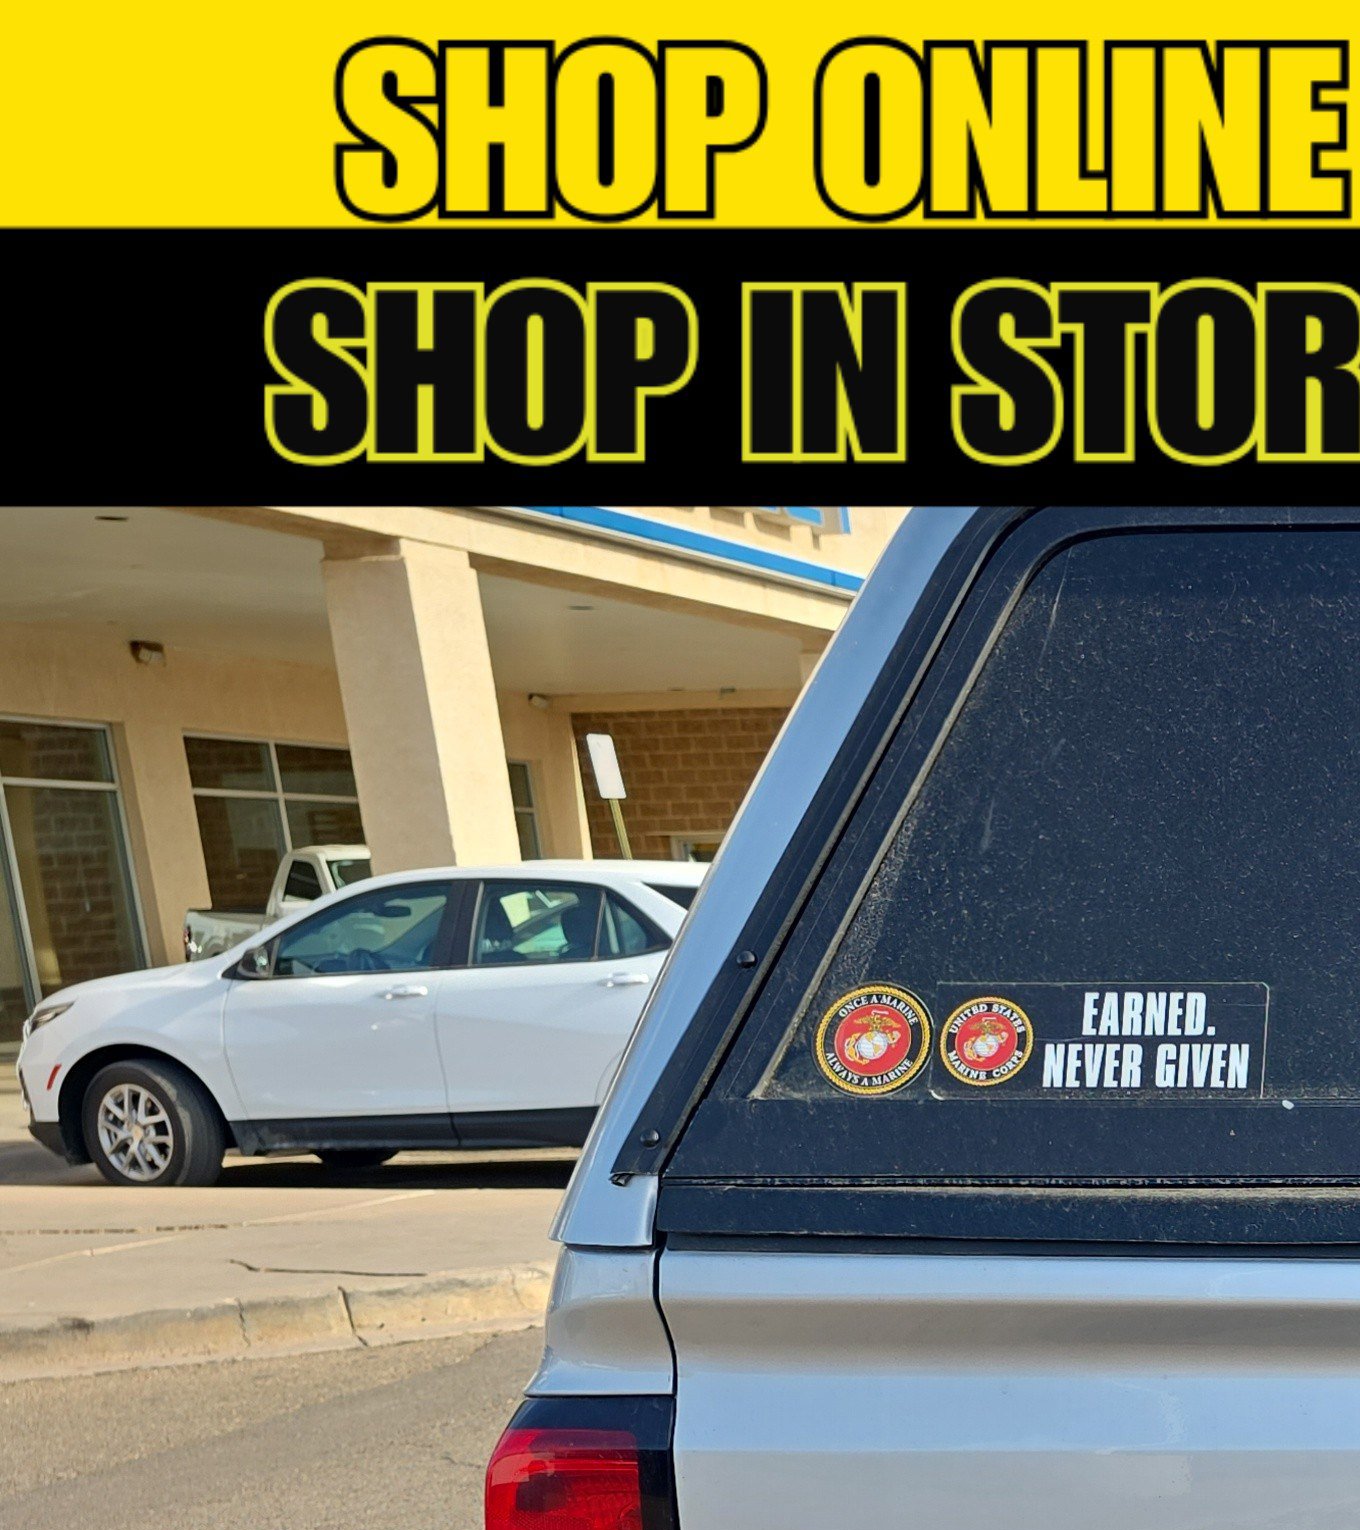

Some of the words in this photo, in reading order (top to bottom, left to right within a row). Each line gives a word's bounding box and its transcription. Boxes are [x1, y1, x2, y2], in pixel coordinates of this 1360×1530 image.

[838, 996, 869, 1018] ONCE
[869, 994, 880, 1005] A
[881, 994, 919, 1026] MARINE
[948, 1003, 988, 1034] UNITED
[991, 1003, 1026, 1033] STATES
[1081, 991, 1216, 1036] EARNED.
[825, 1052, 860, 1085] ALWAYS
[871, 1058, 914, 1086] MARINE
[948, 1049, 987, 1080] MARINE
[992, 1049, 1023, 1078] CORPS
[1042, 1043, 1143, 1088] NEVER
[1155, 1043, 1250, 1089] GIVEN
